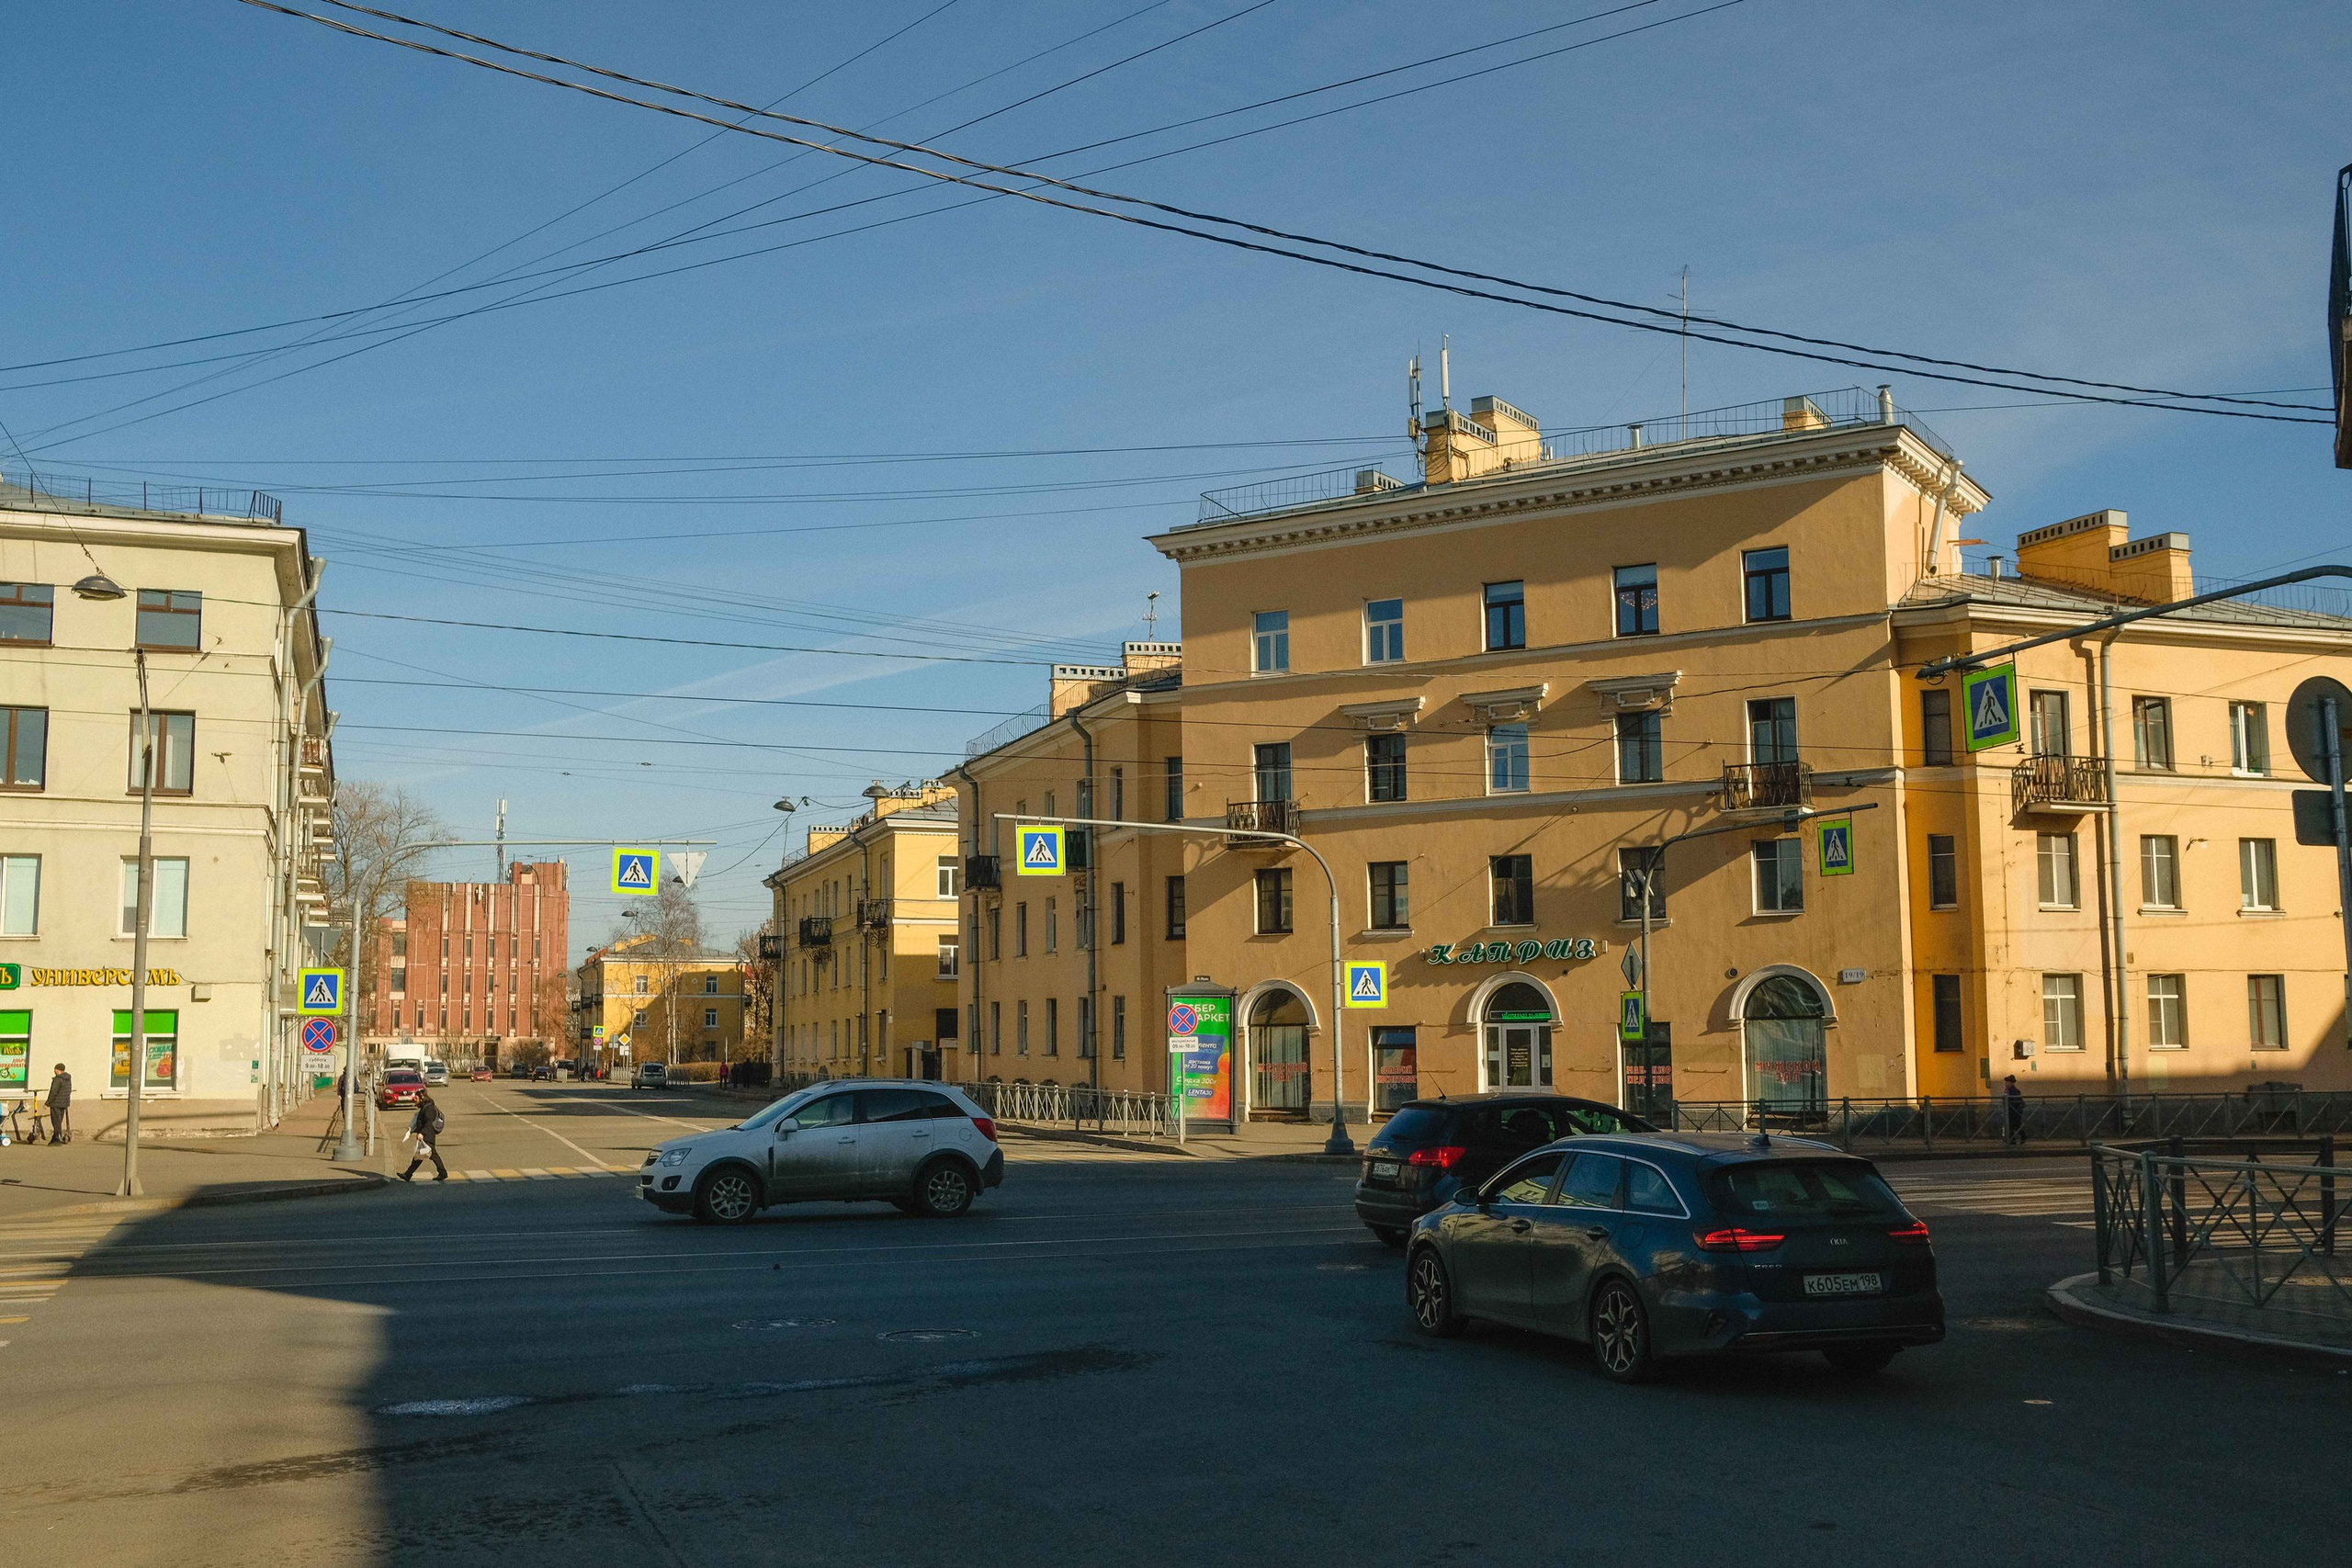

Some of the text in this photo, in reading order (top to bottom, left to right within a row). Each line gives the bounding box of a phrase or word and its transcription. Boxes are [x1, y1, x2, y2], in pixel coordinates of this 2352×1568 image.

[1427, 937, 1596, 964] КАПРИЗ
[31, 968, 180, 987] УНИВЕРСМЪ
[1845, 971, 1864, 979] 19/19
[1192, 1004, 1216, 1012] БЕР
[1258, 1063, 1307, 1072] ЖЕНСКИЙ
[1755, 1059, 1821, 1071] МУЖСКОЙ
[1626, 1066, 1672, 1074] МАНКЮР
[1272, 1073, 1292, 1082] ЗАЛ
[1627, 1075, 1672, 1084] ПЕДКЮР
[1776, 1072, 1801, 1082] ЗАЛ
[1808, 1274, 1878, 1292] К605ЕМ 198
